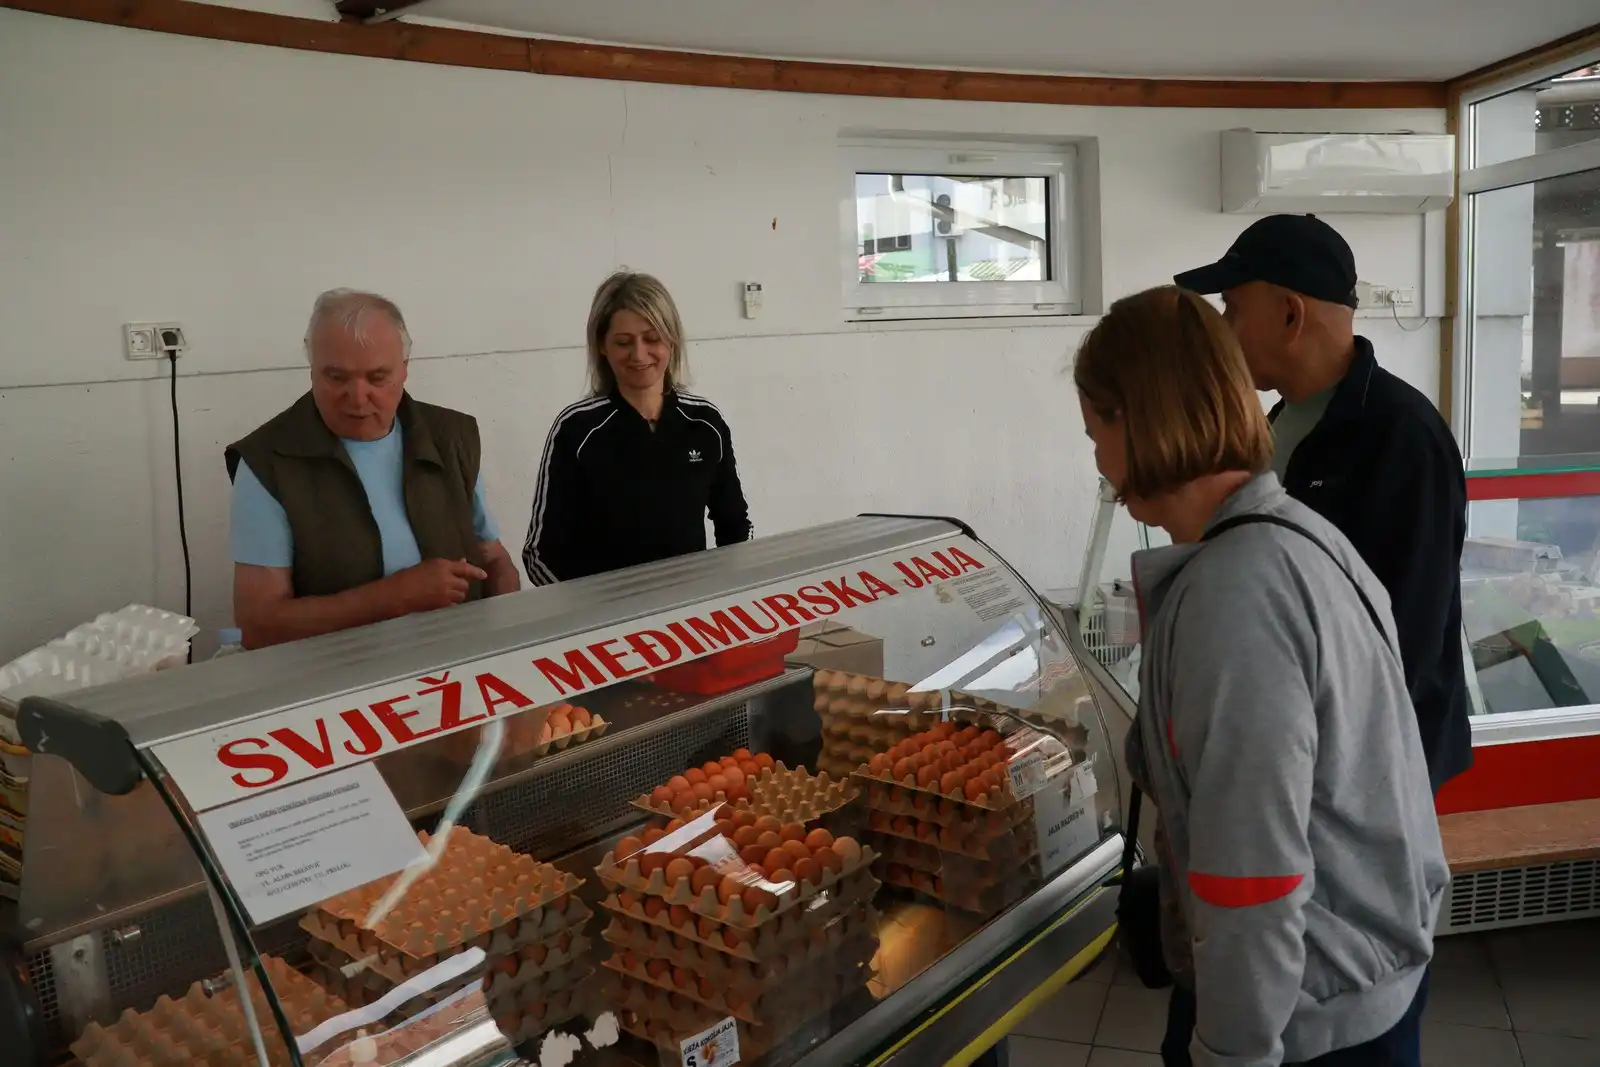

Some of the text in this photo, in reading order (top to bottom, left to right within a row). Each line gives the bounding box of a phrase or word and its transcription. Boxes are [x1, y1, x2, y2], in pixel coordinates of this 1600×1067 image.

[217, 547, 984, 789] SVJEŽA MEĐIMURSKA JAJA
